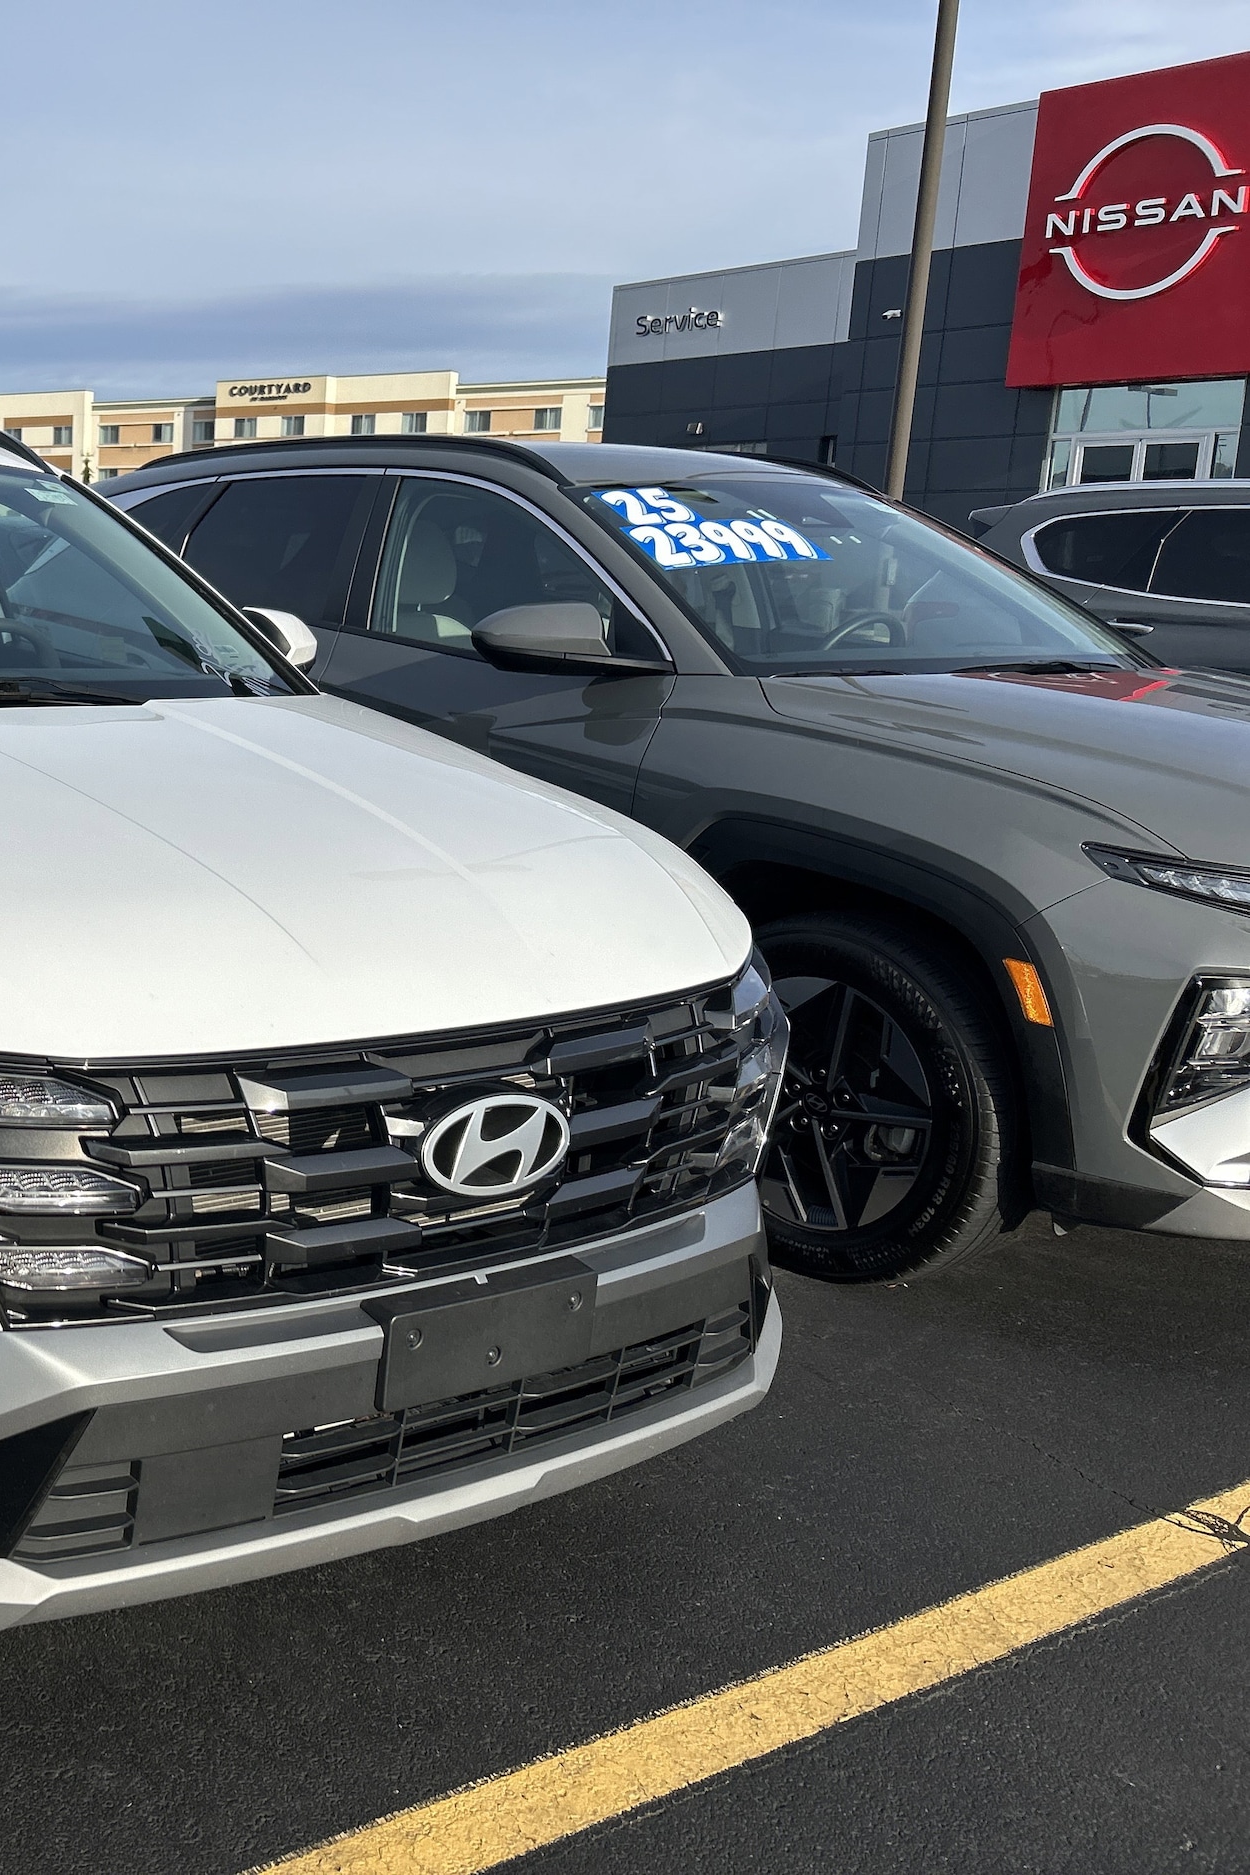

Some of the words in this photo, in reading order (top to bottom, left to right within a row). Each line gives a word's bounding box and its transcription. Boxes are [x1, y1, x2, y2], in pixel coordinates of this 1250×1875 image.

[1045, 186, 1249, 239] NISSAN
[635, 307, 723, 336] Service
[229, 382, 311, 397] COURTYARD
[600, 488, 695, 525] 25
[629, 520, 817, 568] 23999
